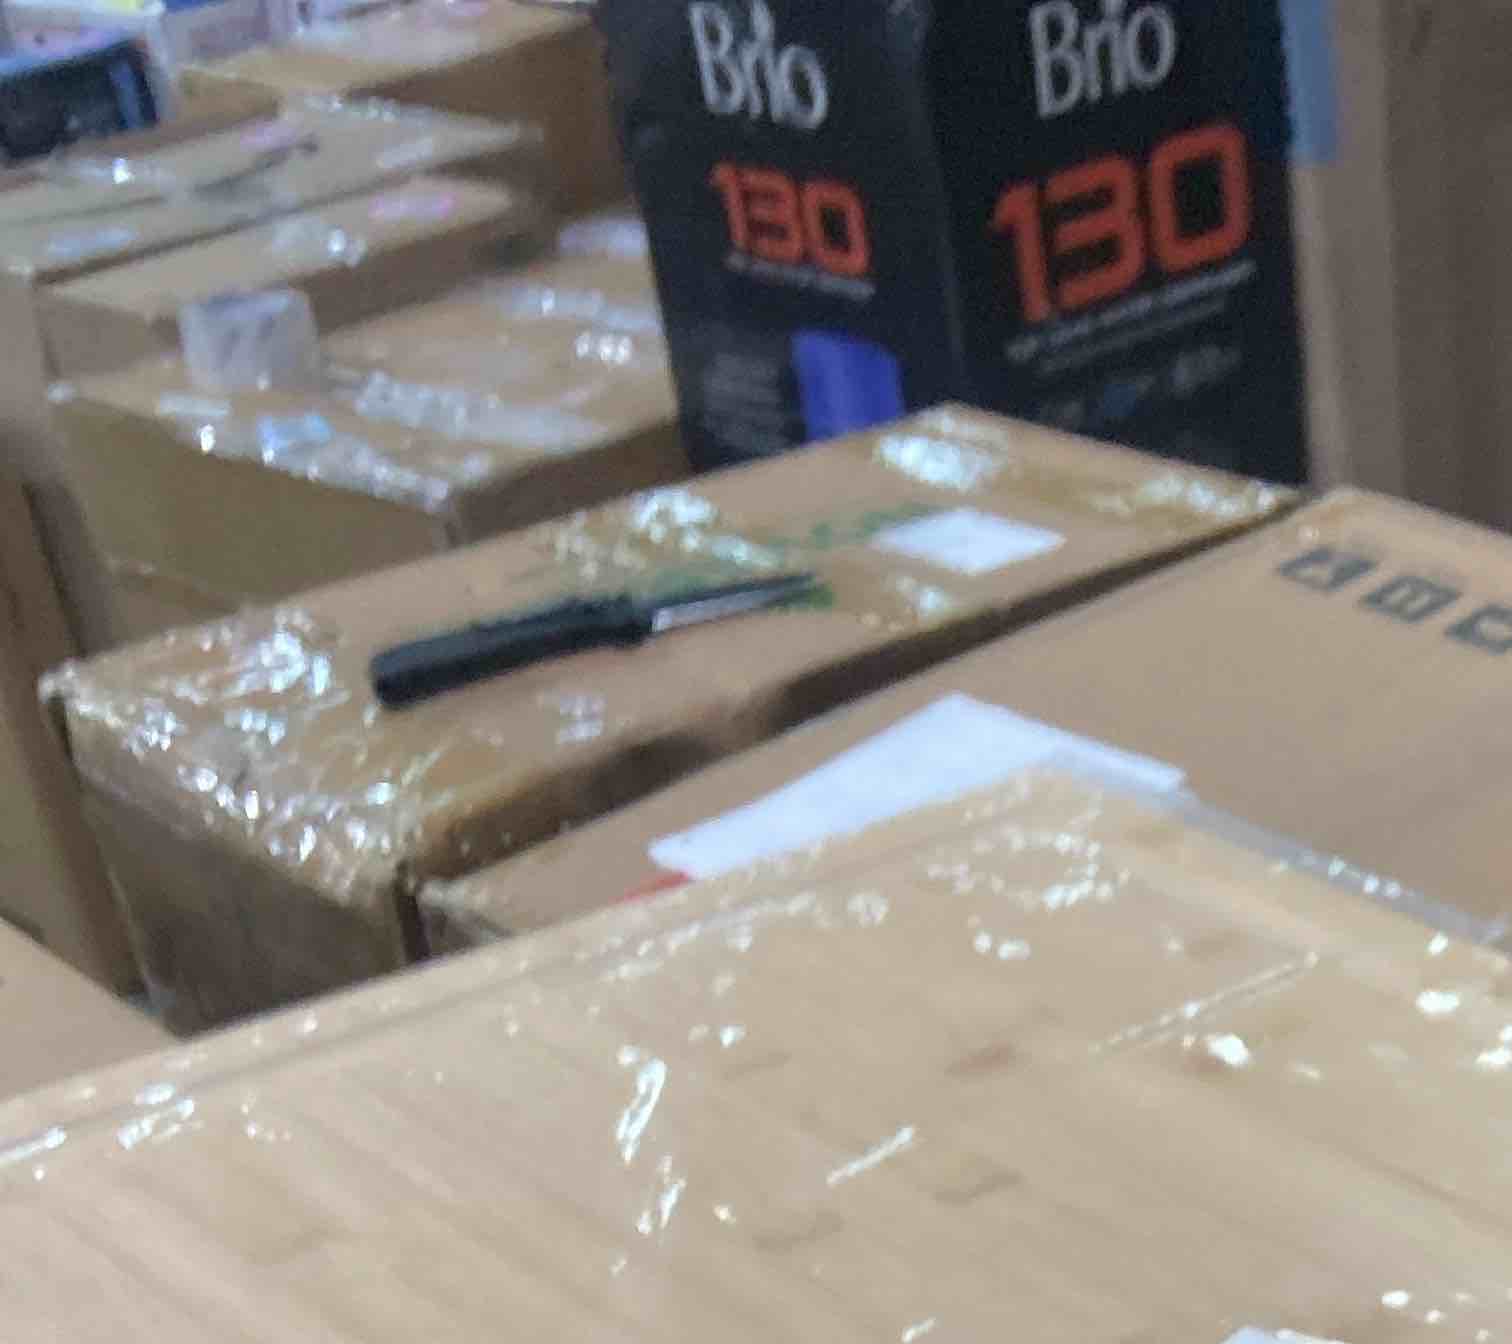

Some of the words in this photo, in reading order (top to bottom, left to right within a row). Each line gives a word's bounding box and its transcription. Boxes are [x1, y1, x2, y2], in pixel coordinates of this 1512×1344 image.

[690, 0, 829, 129] Brio
[1028, 0, 1177, 119] Brio
[712, 158, 872, 277] 130
[993, 122, 1252, 323] 130
